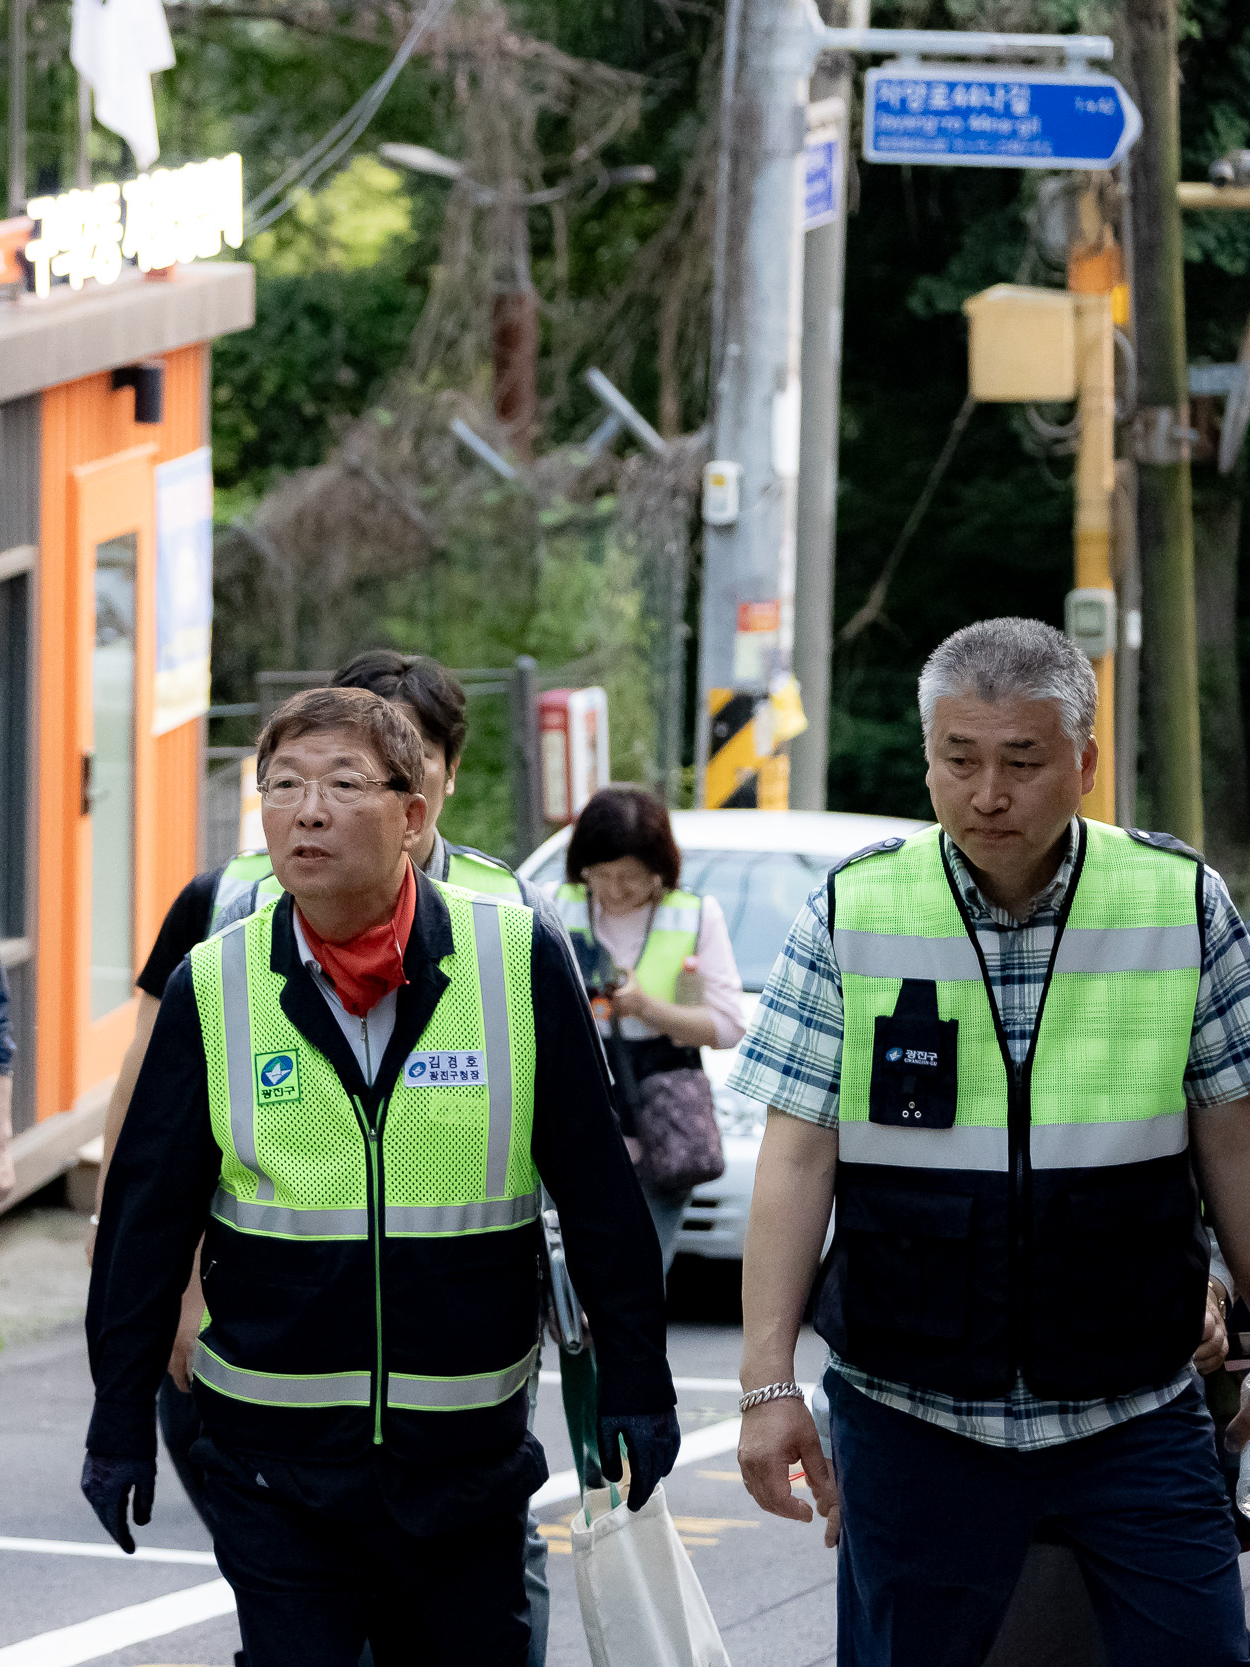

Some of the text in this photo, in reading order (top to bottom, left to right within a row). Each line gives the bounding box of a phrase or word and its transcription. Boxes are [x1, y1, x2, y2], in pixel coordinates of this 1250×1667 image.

[905, 1049, 938, 1061] 광진구
[429, 1070, 480, 1081] 광진구청장
[261, 1086, 295, 1099] 광진구
